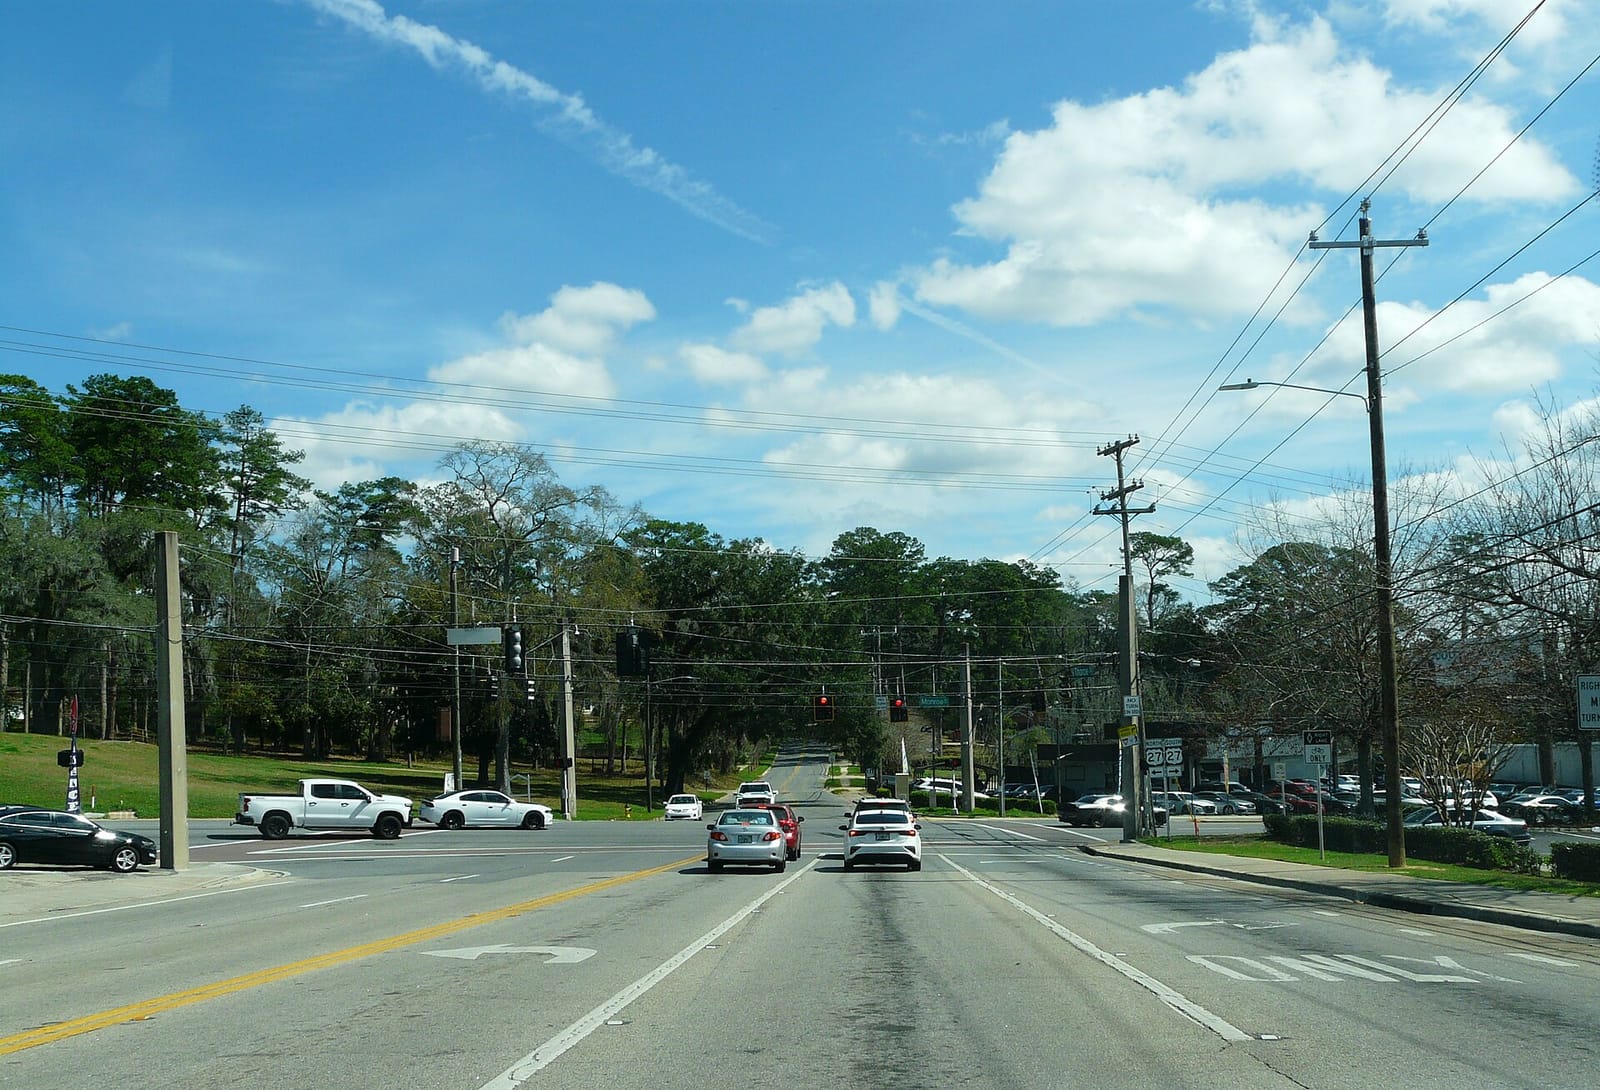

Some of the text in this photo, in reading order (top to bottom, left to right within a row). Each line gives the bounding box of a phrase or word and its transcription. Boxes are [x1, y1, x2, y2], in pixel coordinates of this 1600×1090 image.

[1148, 751, 1162, 762] 27
[1167, 751, 1181, 761] 27
[1310, 754, 1328, 762] ONLY
[1186, 954, 1524, 983] ONLY
